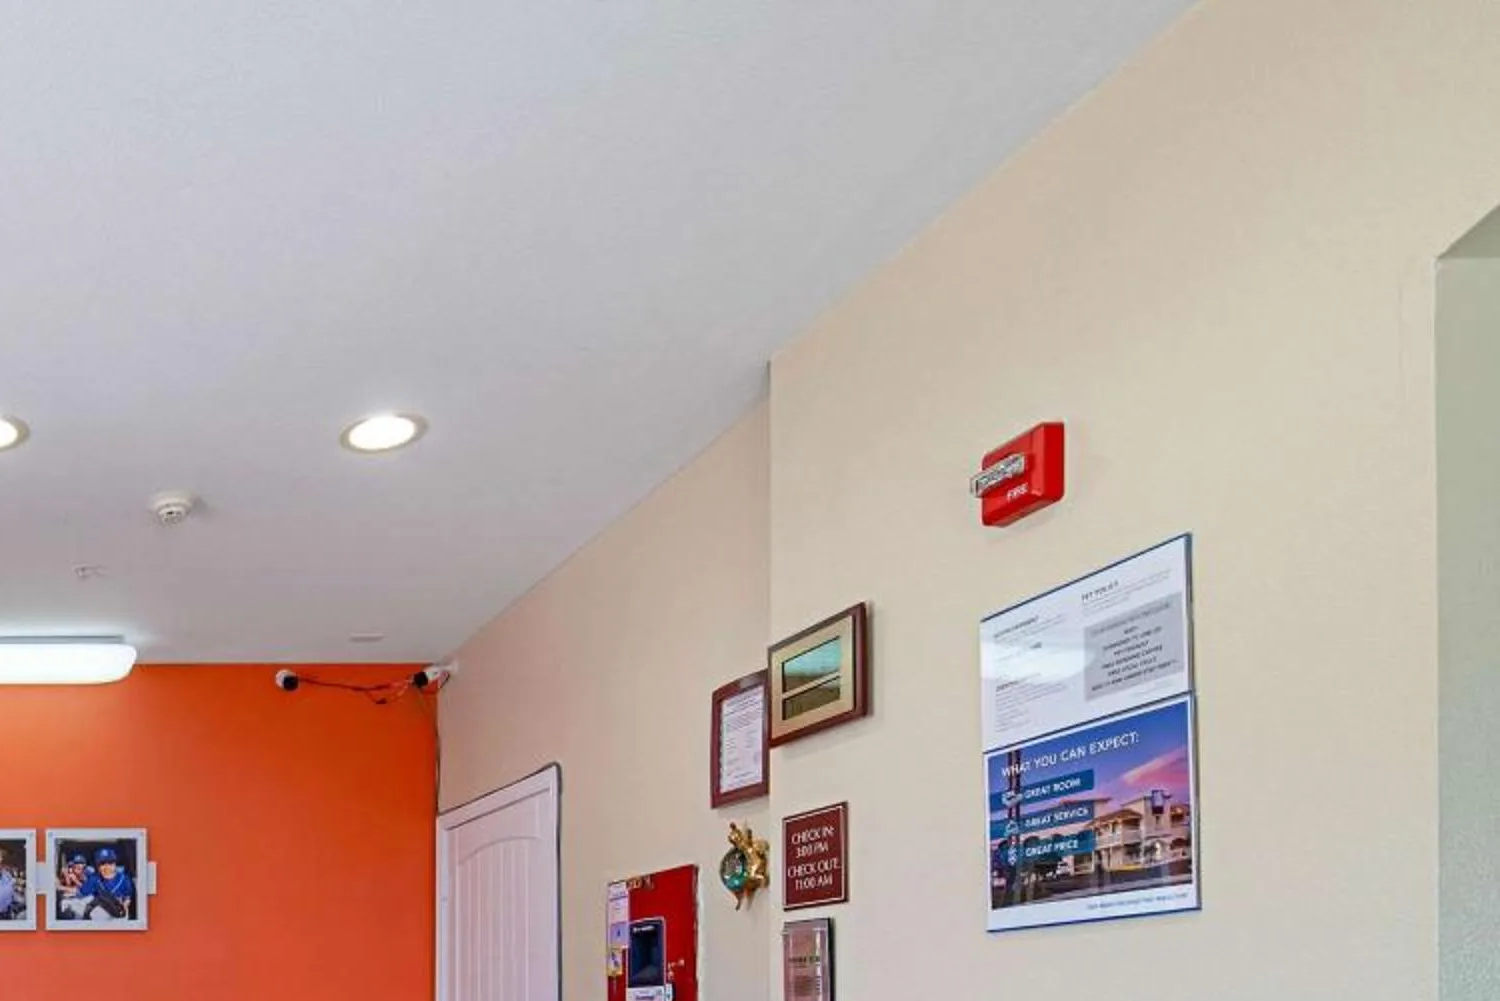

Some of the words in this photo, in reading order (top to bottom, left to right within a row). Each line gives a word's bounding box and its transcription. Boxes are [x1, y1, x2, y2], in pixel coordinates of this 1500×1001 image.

[1001, 760, 1031, 777] WHAT
[1033, 754, 1057, 768] YOU
[1060, 746, 1086, 762] CAN
[1089, 731, 1140, 755] EXPECT:
[1025, 785, 1051, 799] GREAT
[1053, 778, 1081, 791] ROOM
[1053, 807, 1089, 824] SERVICE
[791, 828, 821, 845] CHECK
[814, 841, 829, 853] PM
[1025, 843, 1053, 857] GREAT
[1055, 839, 1079, 851] PRICE
[787, 862, 817, 878] CHECK
[818, 873, 833, 887] AM
